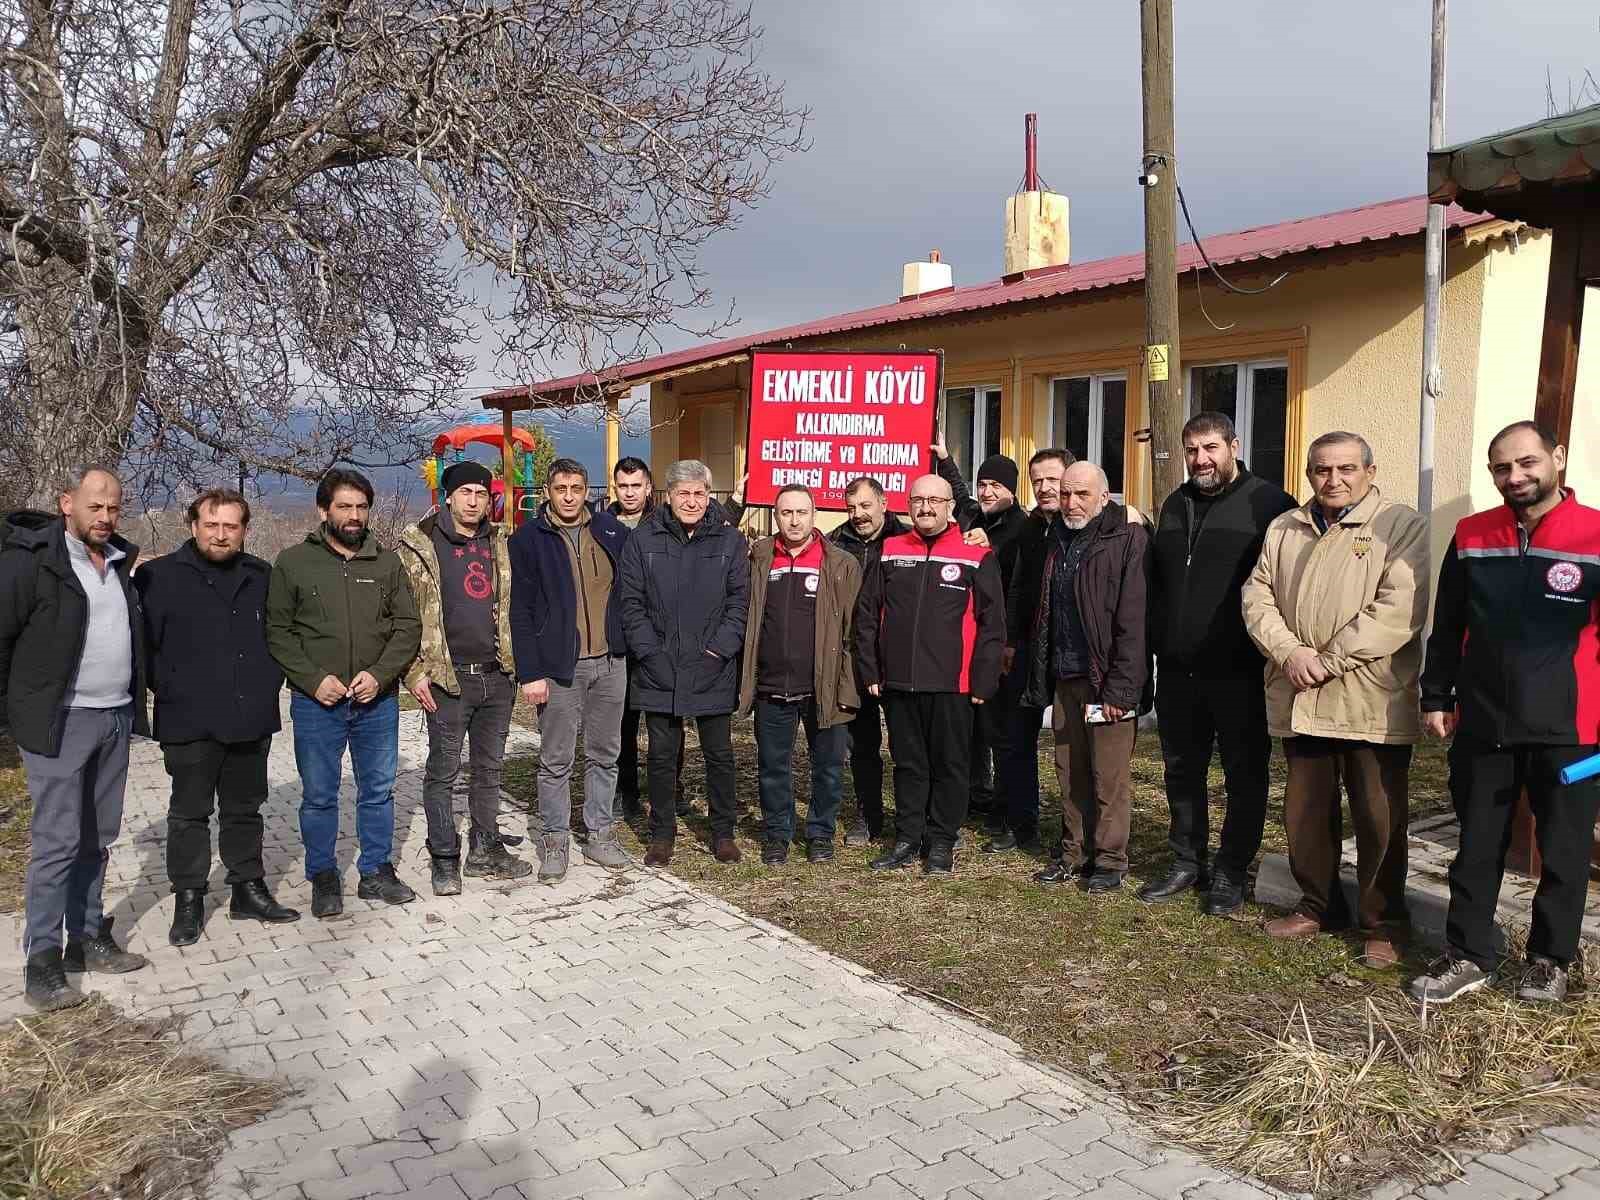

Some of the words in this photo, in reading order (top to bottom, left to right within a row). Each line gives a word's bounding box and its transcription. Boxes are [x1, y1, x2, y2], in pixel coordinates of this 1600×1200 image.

[763, 365, 853, 403] EKMEKLİ
[865, 366, 926, 404] KÖYÜ
[796, 413, 885, 436] KALKINDIRMA
[762, 438, 832, 464] GELİŞTİRME
[863, 443, 919, 466] KORUMA
